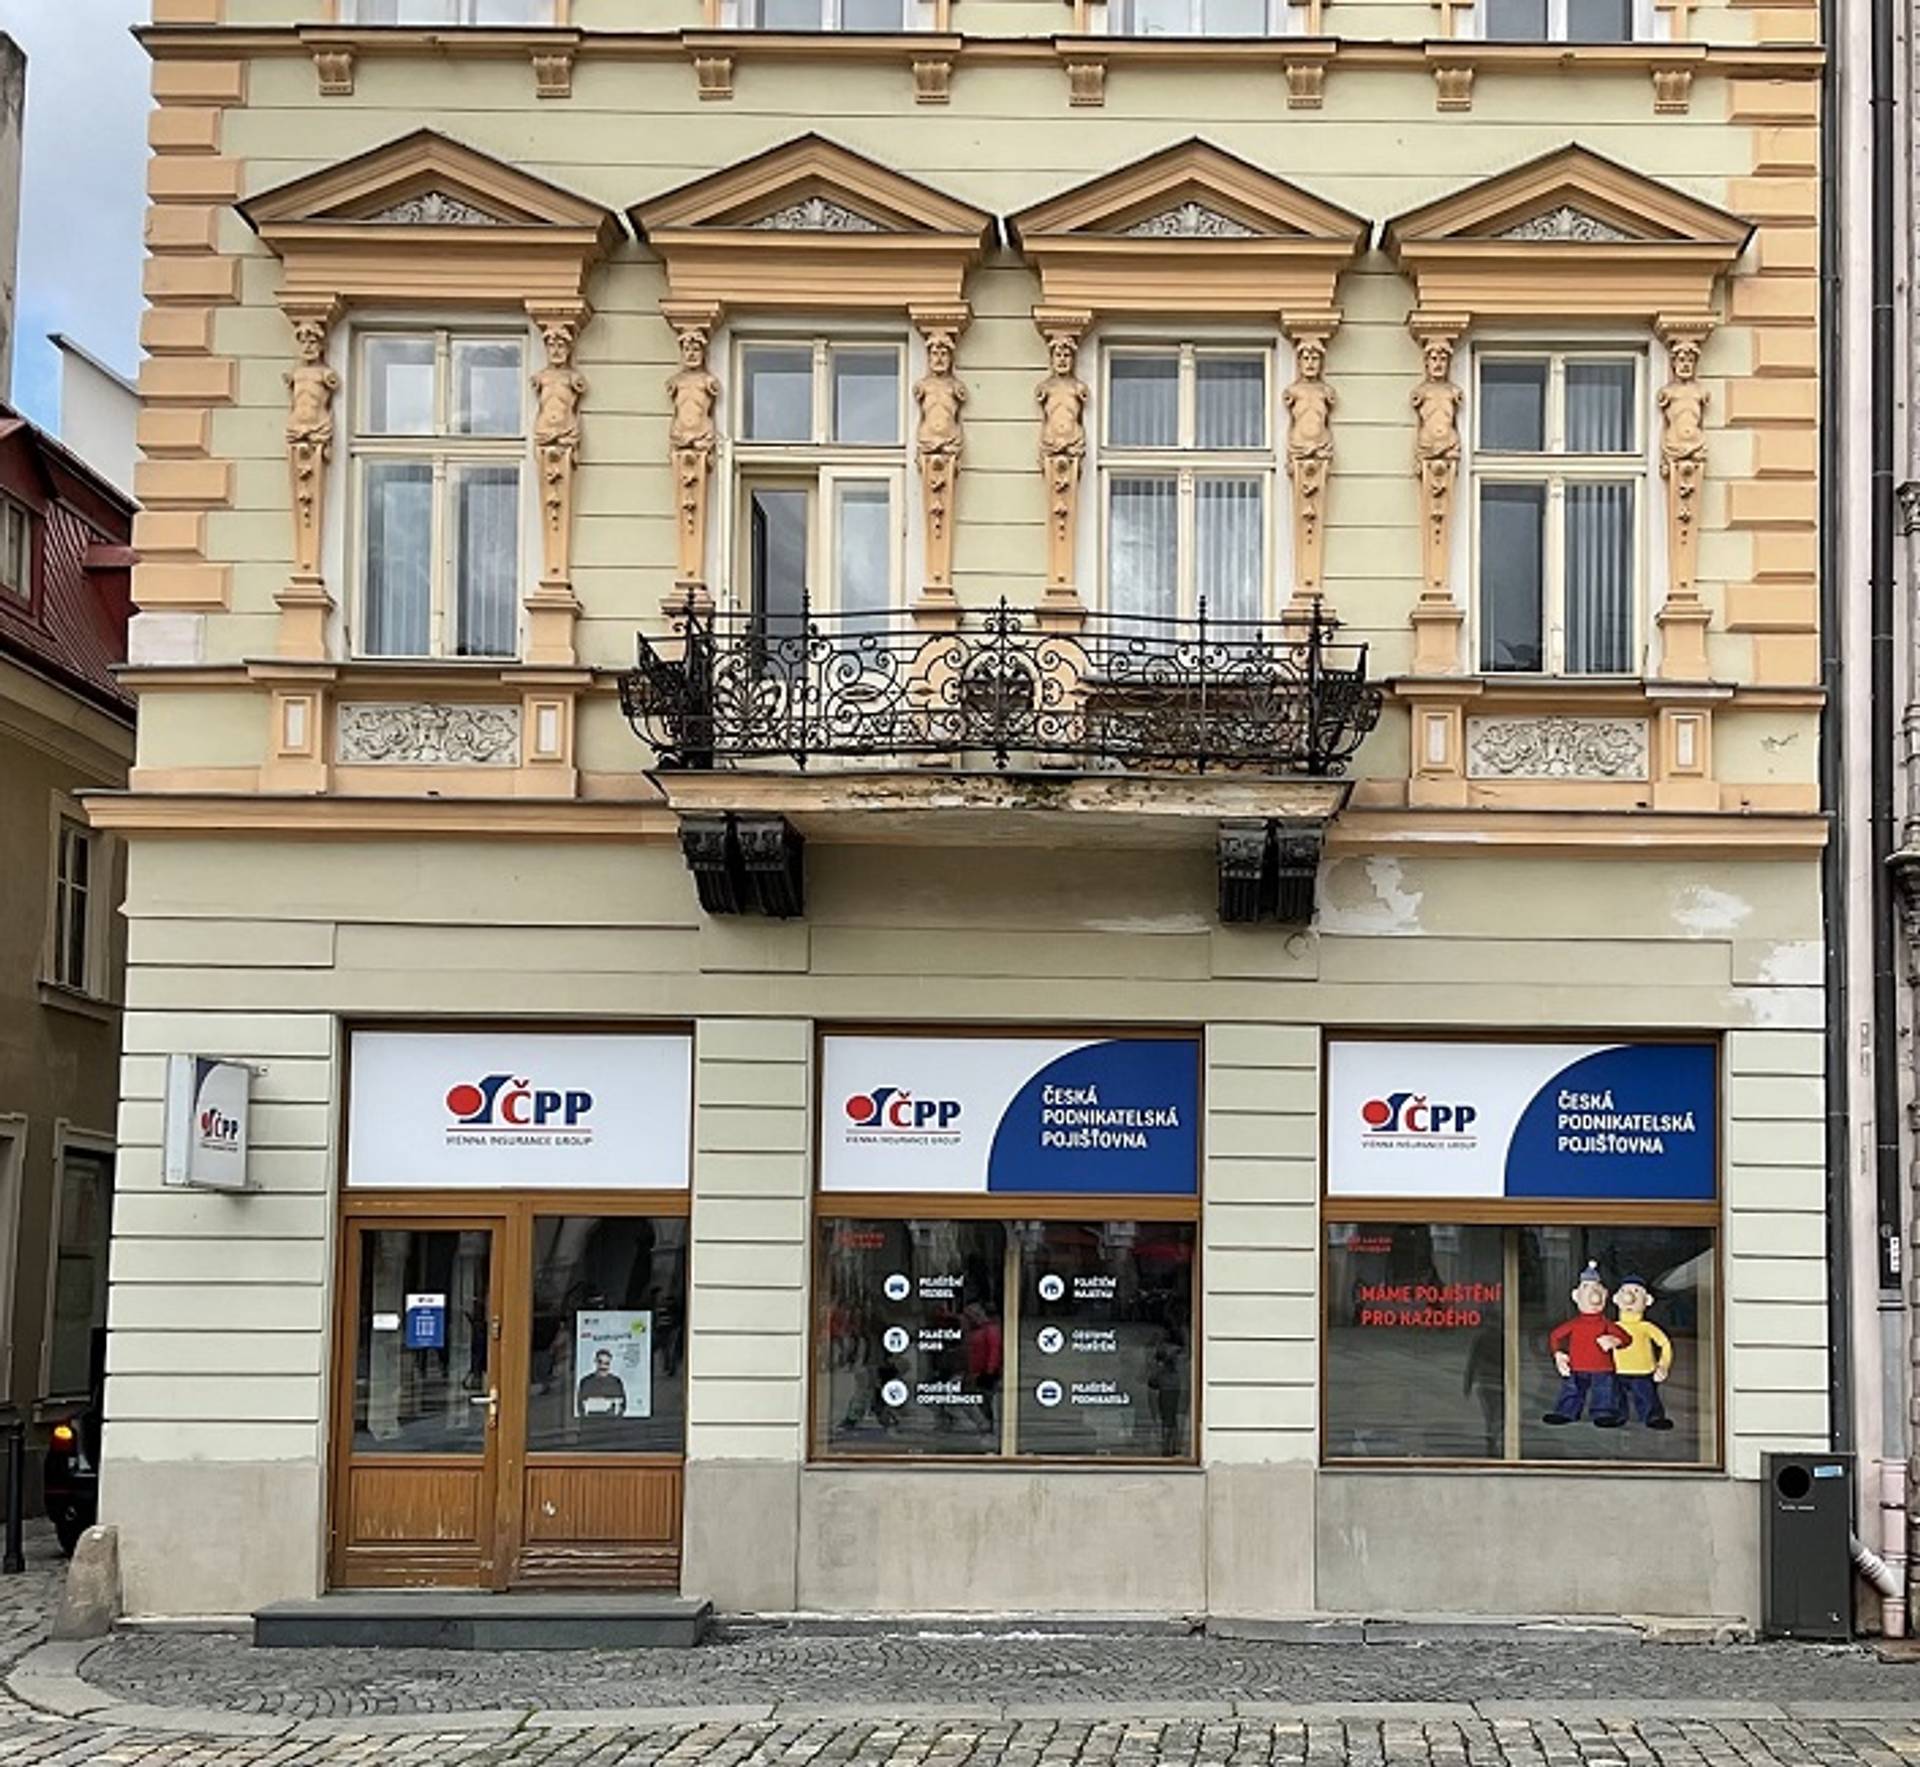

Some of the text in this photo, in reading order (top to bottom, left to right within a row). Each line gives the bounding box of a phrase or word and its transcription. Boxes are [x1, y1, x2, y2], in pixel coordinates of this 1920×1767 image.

[501, 1079, 593, 1125] ČPP
[1042, 1084, 1098, 1105] ČESKÁ
[1557, 1089, 1614, 1110] ČESKÁ
[888, 1090, 962, 1128] ČPP
[1041, 1106, 1180, 1127] PODNIKATELSKÁ
[1405, 1095, 1477, 1133] ČPP
[1557, 1111, 1697, 1132] PODNIKATELSKÁ
[1041, 1128, 1149, 1149] POJIŠŤOVNA
[1557, 1133, 1665, 1154] POJIŠŤOVNA
[1361, 1281, 1503, 1303] MÁME POJIŠTĚNÍ
[1361, 1306, 1482, 1327] PRO KAŽDÉHO
